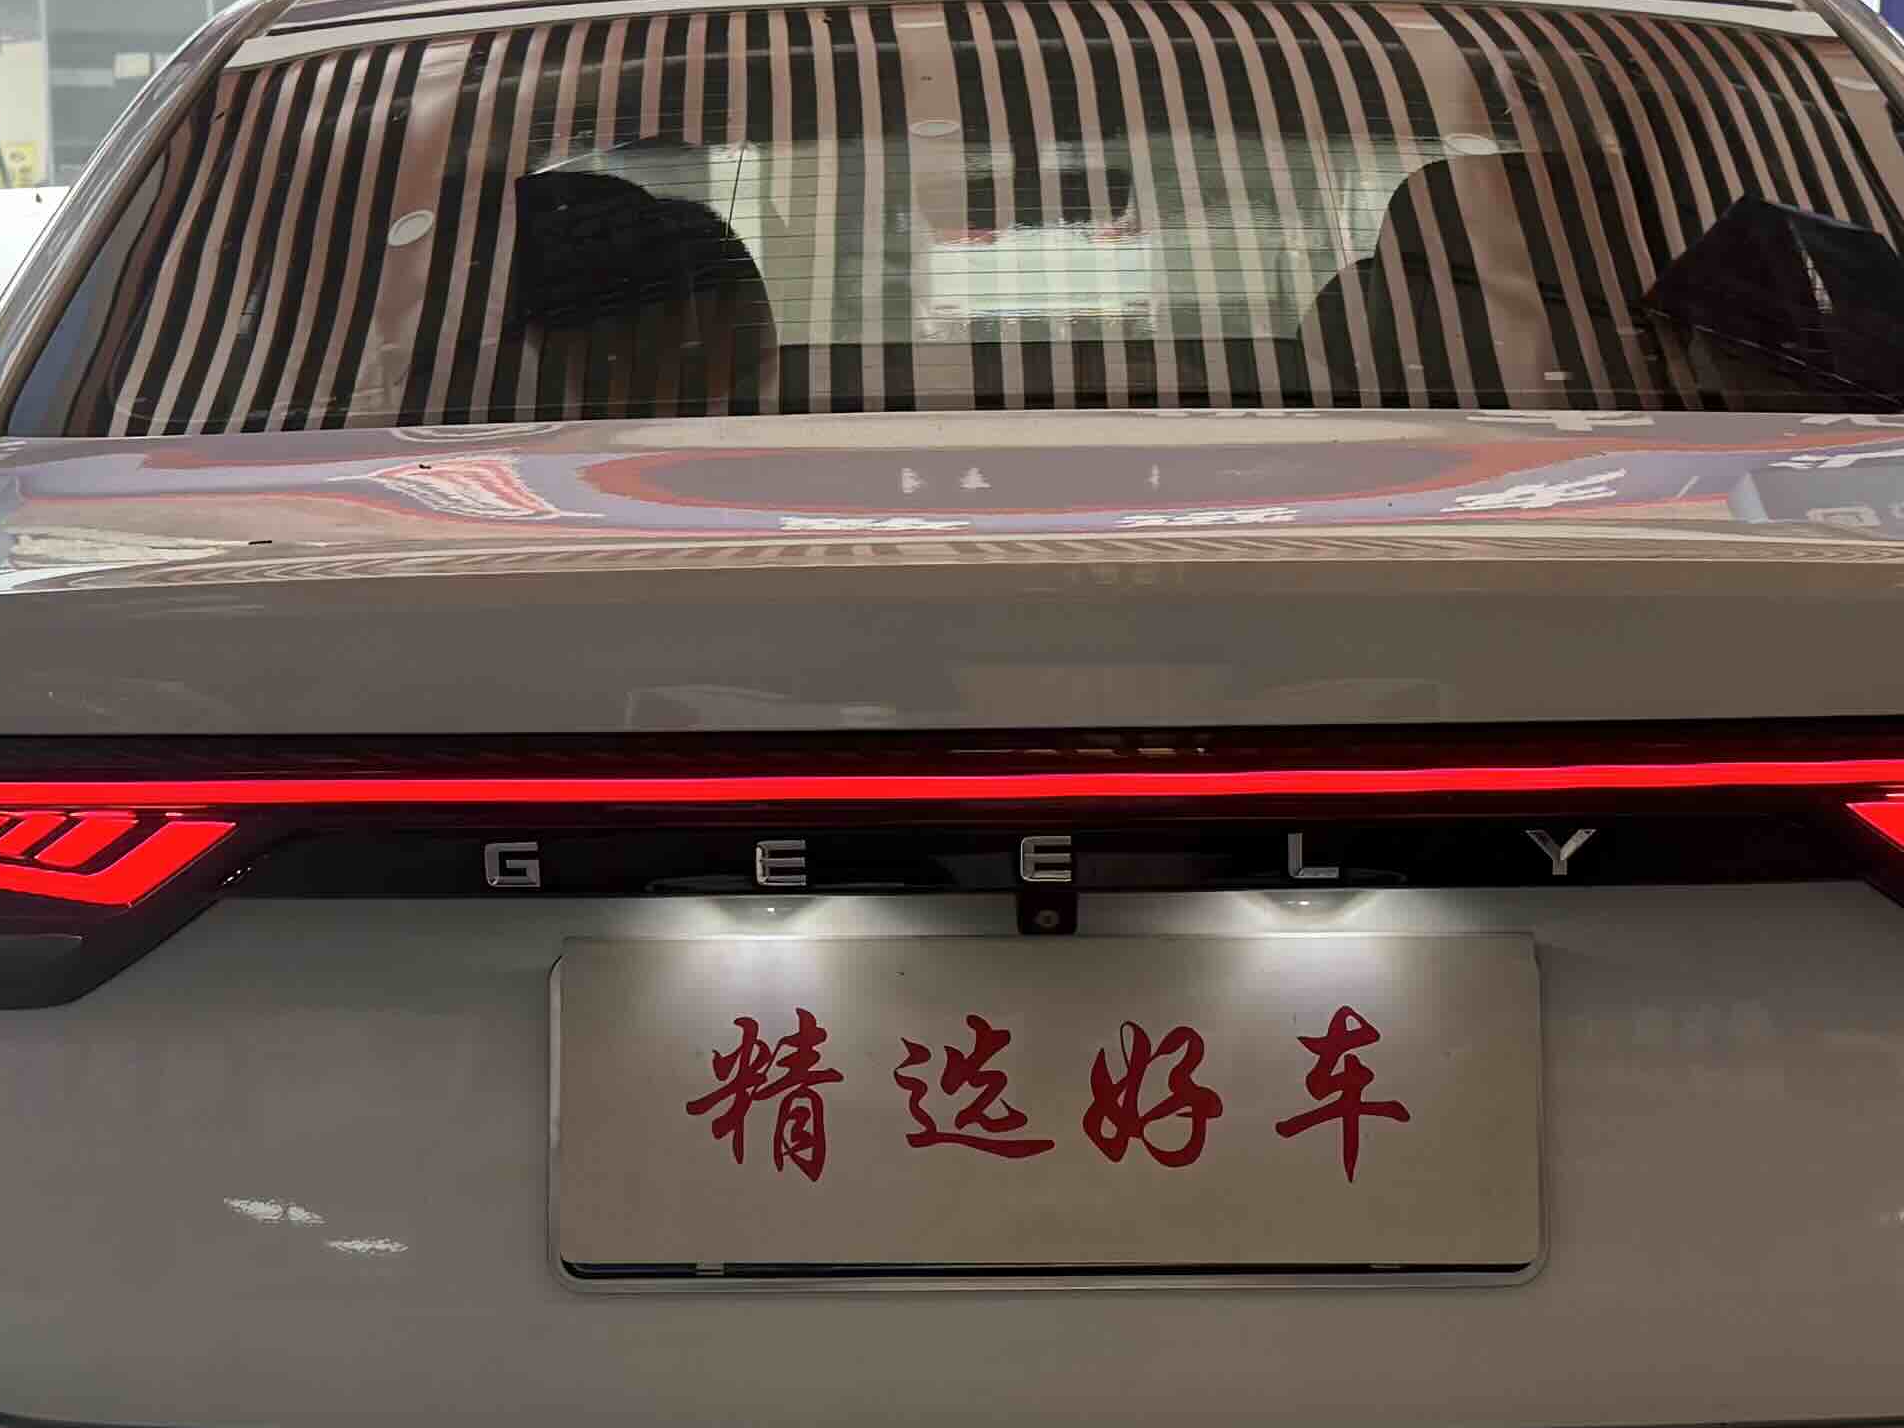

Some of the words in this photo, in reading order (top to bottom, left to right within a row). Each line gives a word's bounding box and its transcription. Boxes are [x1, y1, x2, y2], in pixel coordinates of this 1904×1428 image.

[483, 826, 1598, 890] GEELY
[684, 1002, 1412, 1185] 精选好车
